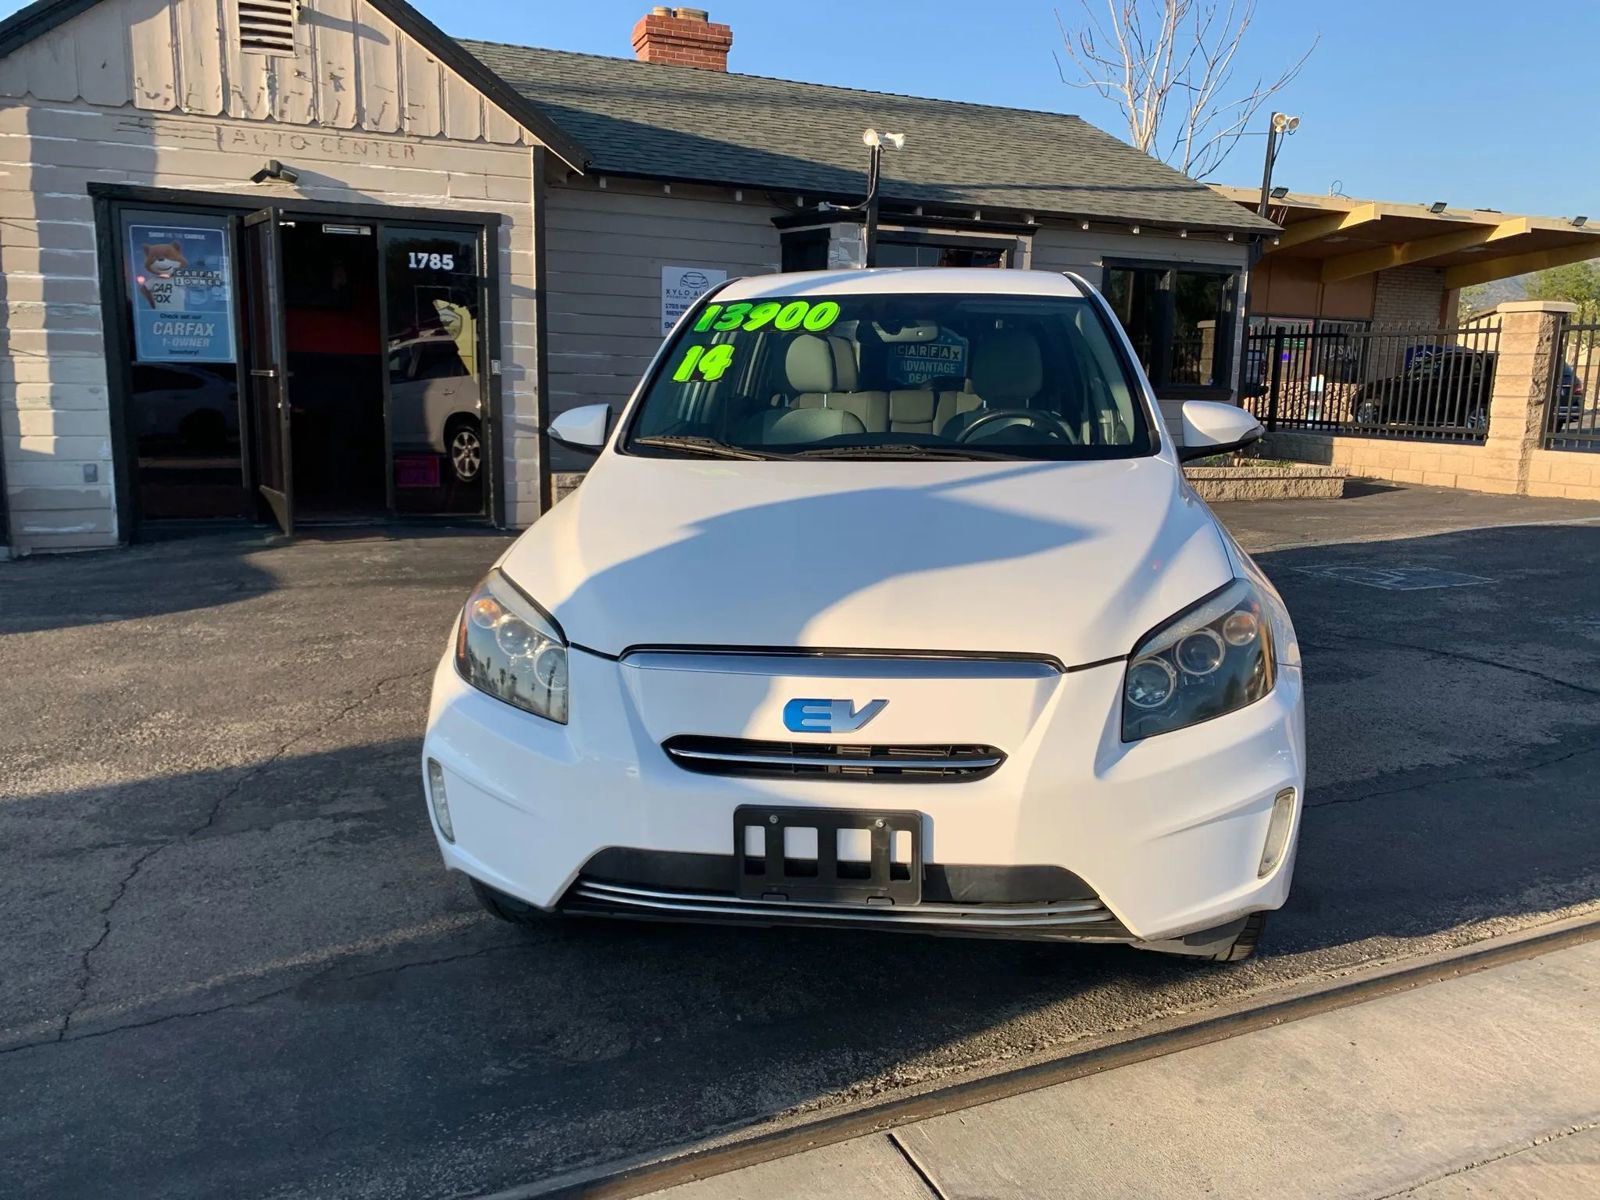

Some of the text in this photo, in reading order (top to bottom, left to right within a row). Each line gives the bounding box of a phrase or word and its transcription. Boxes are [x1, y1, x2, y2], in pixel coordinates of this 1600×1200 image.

[408, 252, 455, 270] 1785
[151, 283, 172, 293] CAR
[693, 301, 841, 333] 13900
[152, 321, 215, 336] CARFAX
[162, 337, 210, 347] 1-OWNER
[896, 344, 962, 361] CARFAX
[671, 345, 736, 382] 14
[782, 697, 890, 734] EV
